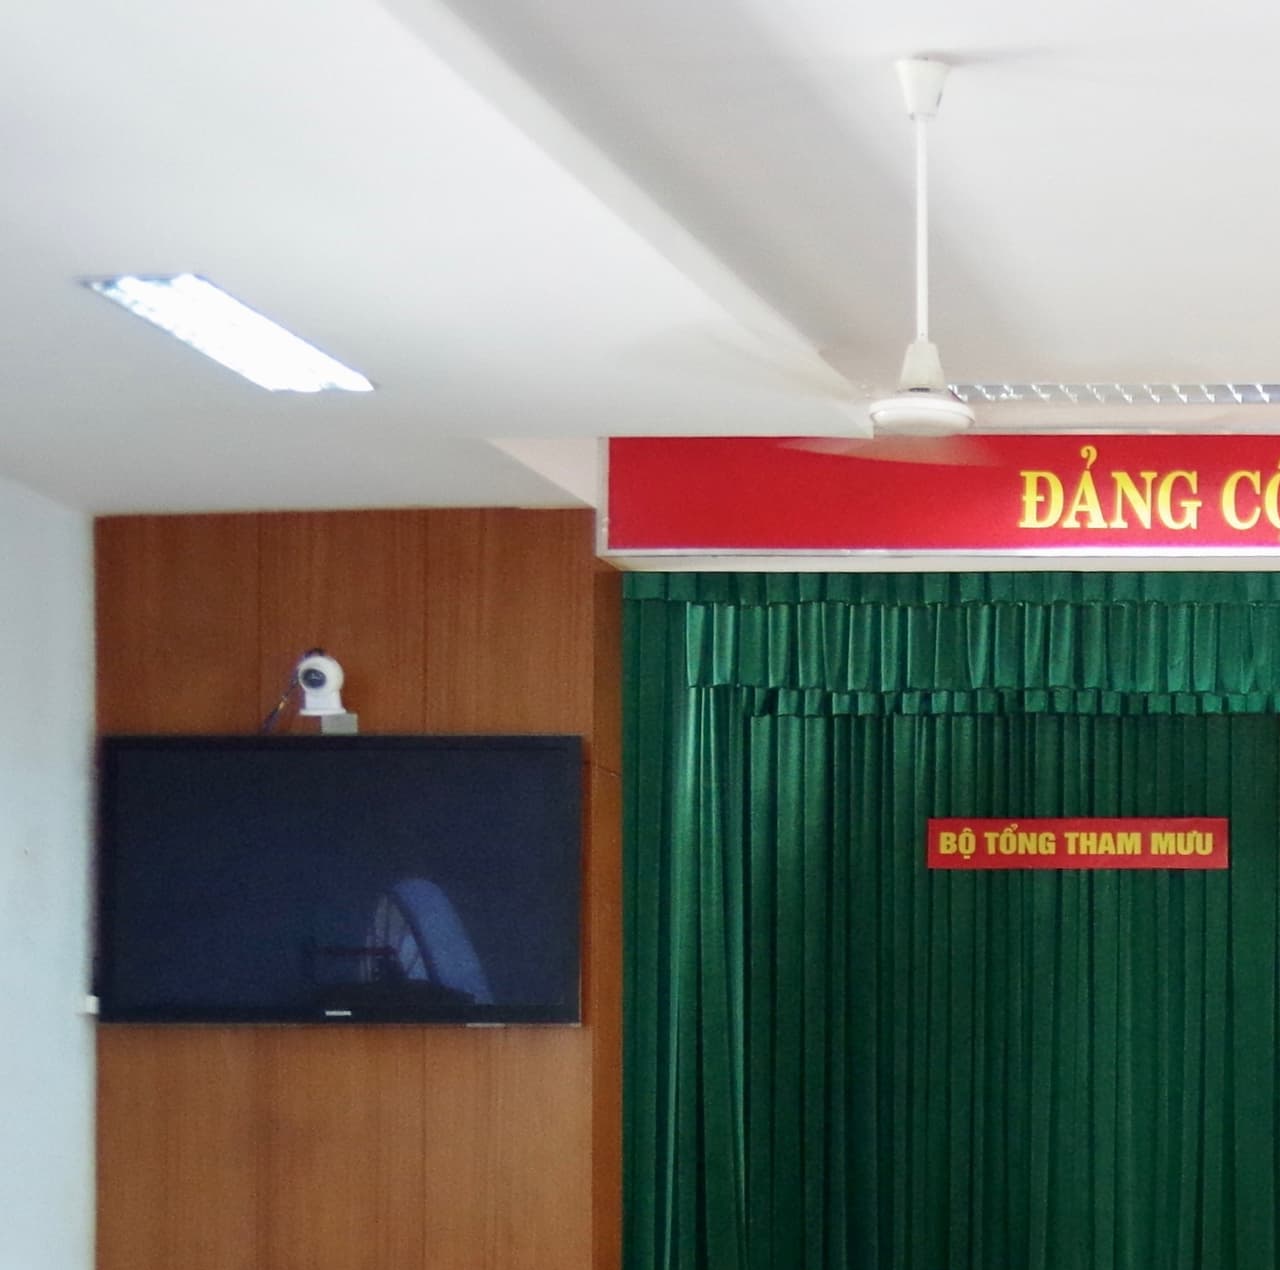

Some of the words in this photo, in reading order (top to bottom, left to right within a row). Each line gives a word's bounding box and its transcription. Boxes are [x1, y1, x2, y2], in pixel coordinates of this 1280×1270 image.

[1018, 445, 1203, 531] ĐẢNG
[939, 827, 976, 859] BỘ
[984, 823, 1056, 855] TỔNG
[1064, 832, 1142, 855] THAM
[1150, 830, 1213, 856] MƯU
